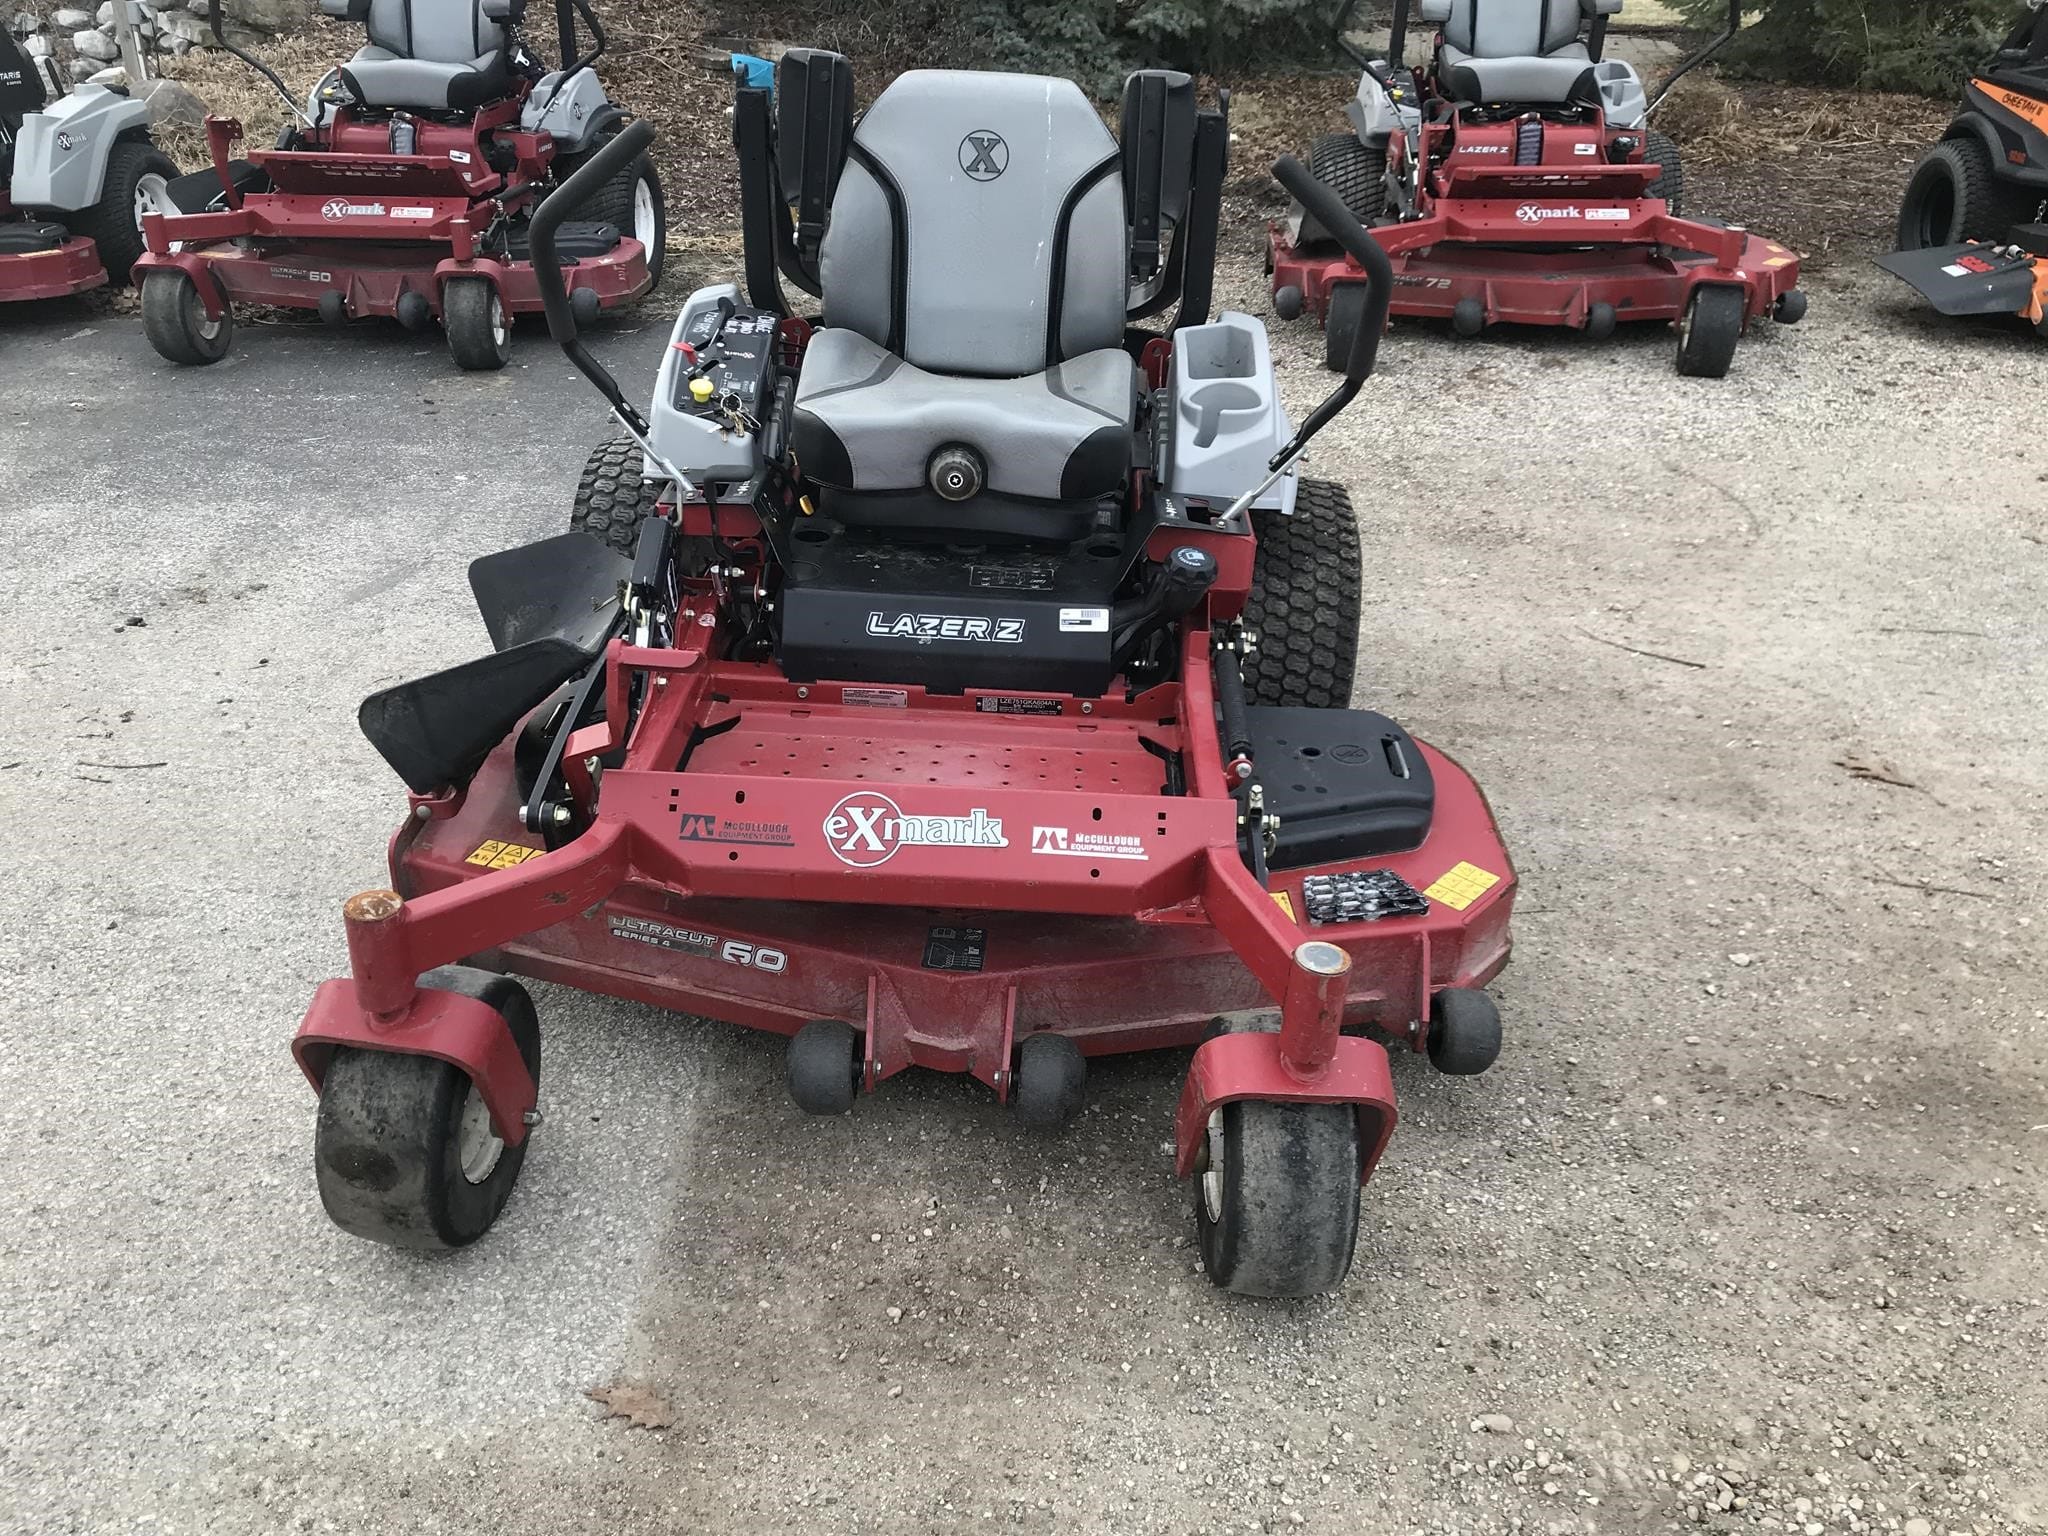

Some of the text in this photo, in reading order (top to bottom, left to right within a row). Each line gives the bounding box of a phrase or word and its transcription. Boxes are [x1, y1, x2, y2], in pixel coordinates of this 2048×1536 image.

[2002, 93, 2036, 113] CHEETAH
[965, 136, 1002, 174] X
[1459, 145, 1497, 153] LAZER
[321, 202, 387, 219] eXmark
[1515, 205, 1582, 223] eXmark
[309, 271, 331, 283] 60
[1425, 277, 1452, 289] 72
[866, 612, 1025, 643] LAZER Z
[719, 831, 791, 841] EQUIPMENT GROUP
[825, 805, 1004, 853] eXmark
[1070, 843, 1145, 854] EQUIPMENT GROUP
[612, 929, 660, 945] SERIES
[612, 915, 787, 973] ULTRACUT 60
